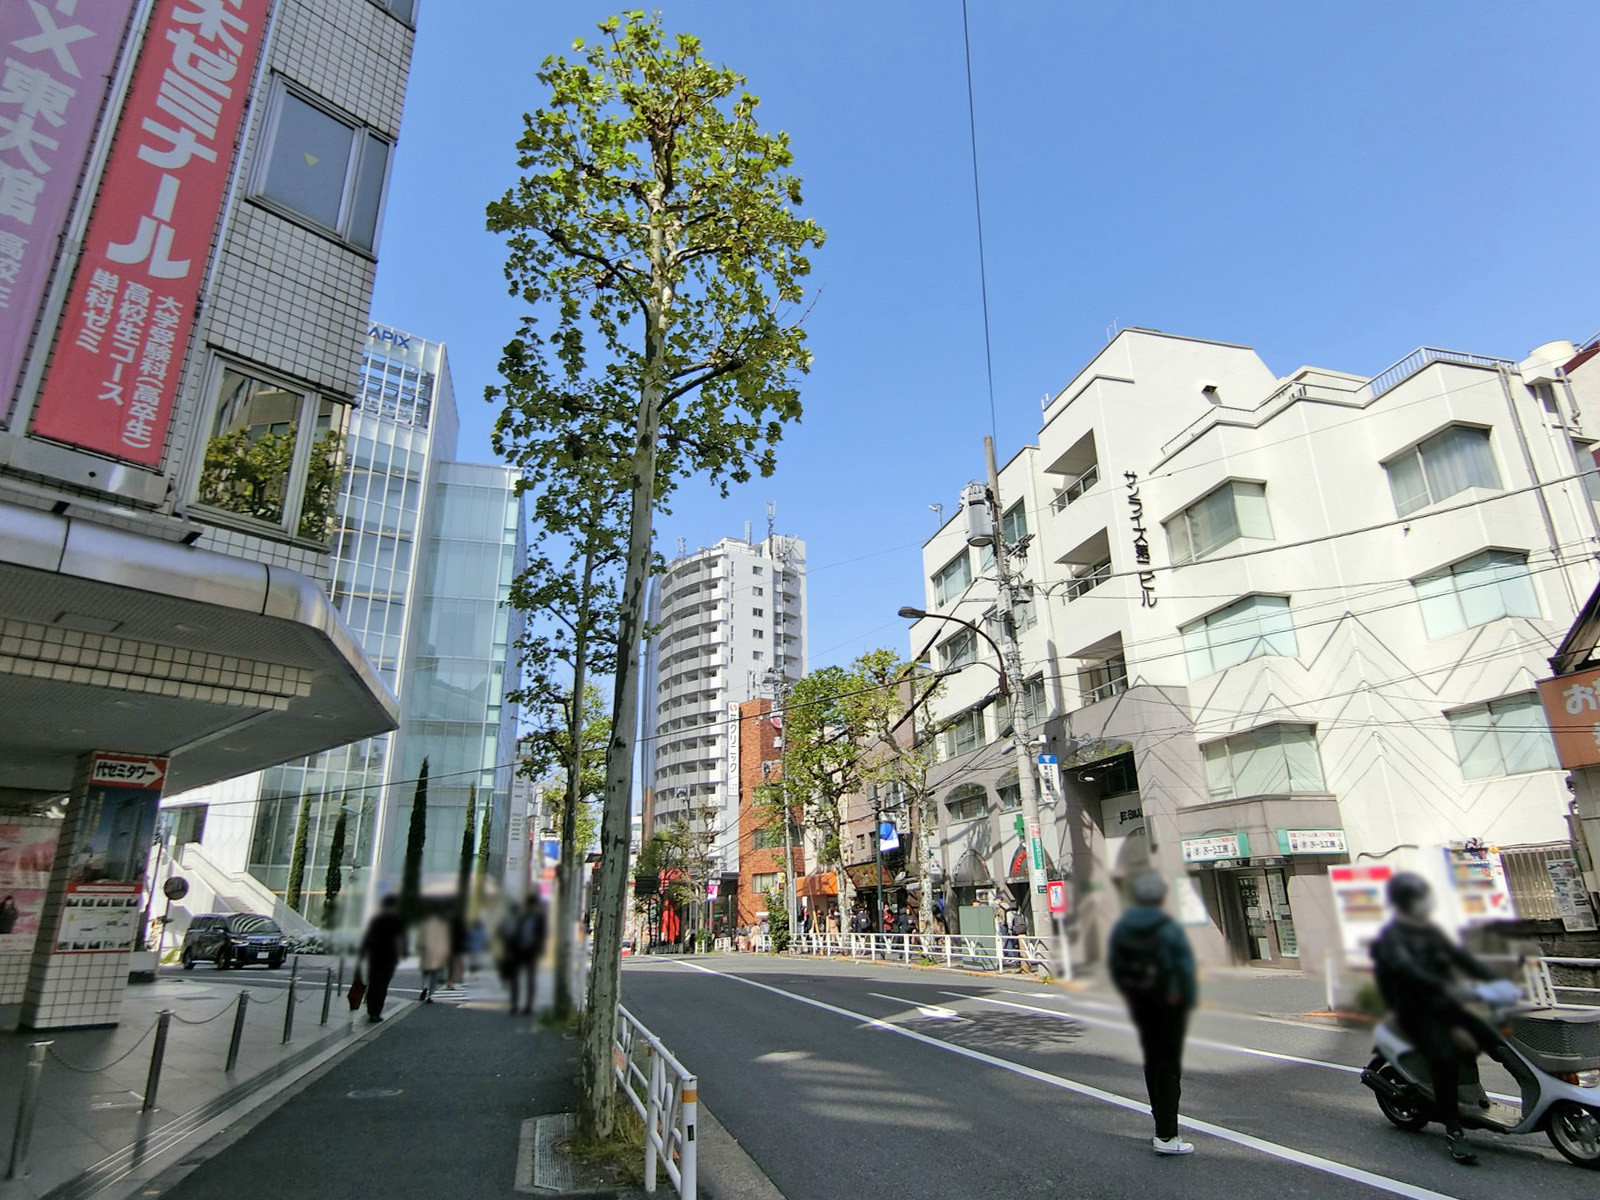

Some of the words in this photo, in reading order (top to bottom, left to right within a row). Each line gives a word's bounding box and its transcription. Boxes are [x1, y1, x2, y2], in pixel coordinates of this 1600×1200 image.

[0, 0, 98, 226] X東大館
[106, 0, 249, 279] 木ゼミナール
[77, 268, 120, 354] 単科ゼミ
[98, 280, 153, 406] 高校生コース
[368, 326, 411, 350] APIX
[1562, 678, 1600, 715] お
[96, 760, 156, 779] 代ゼミタワー
